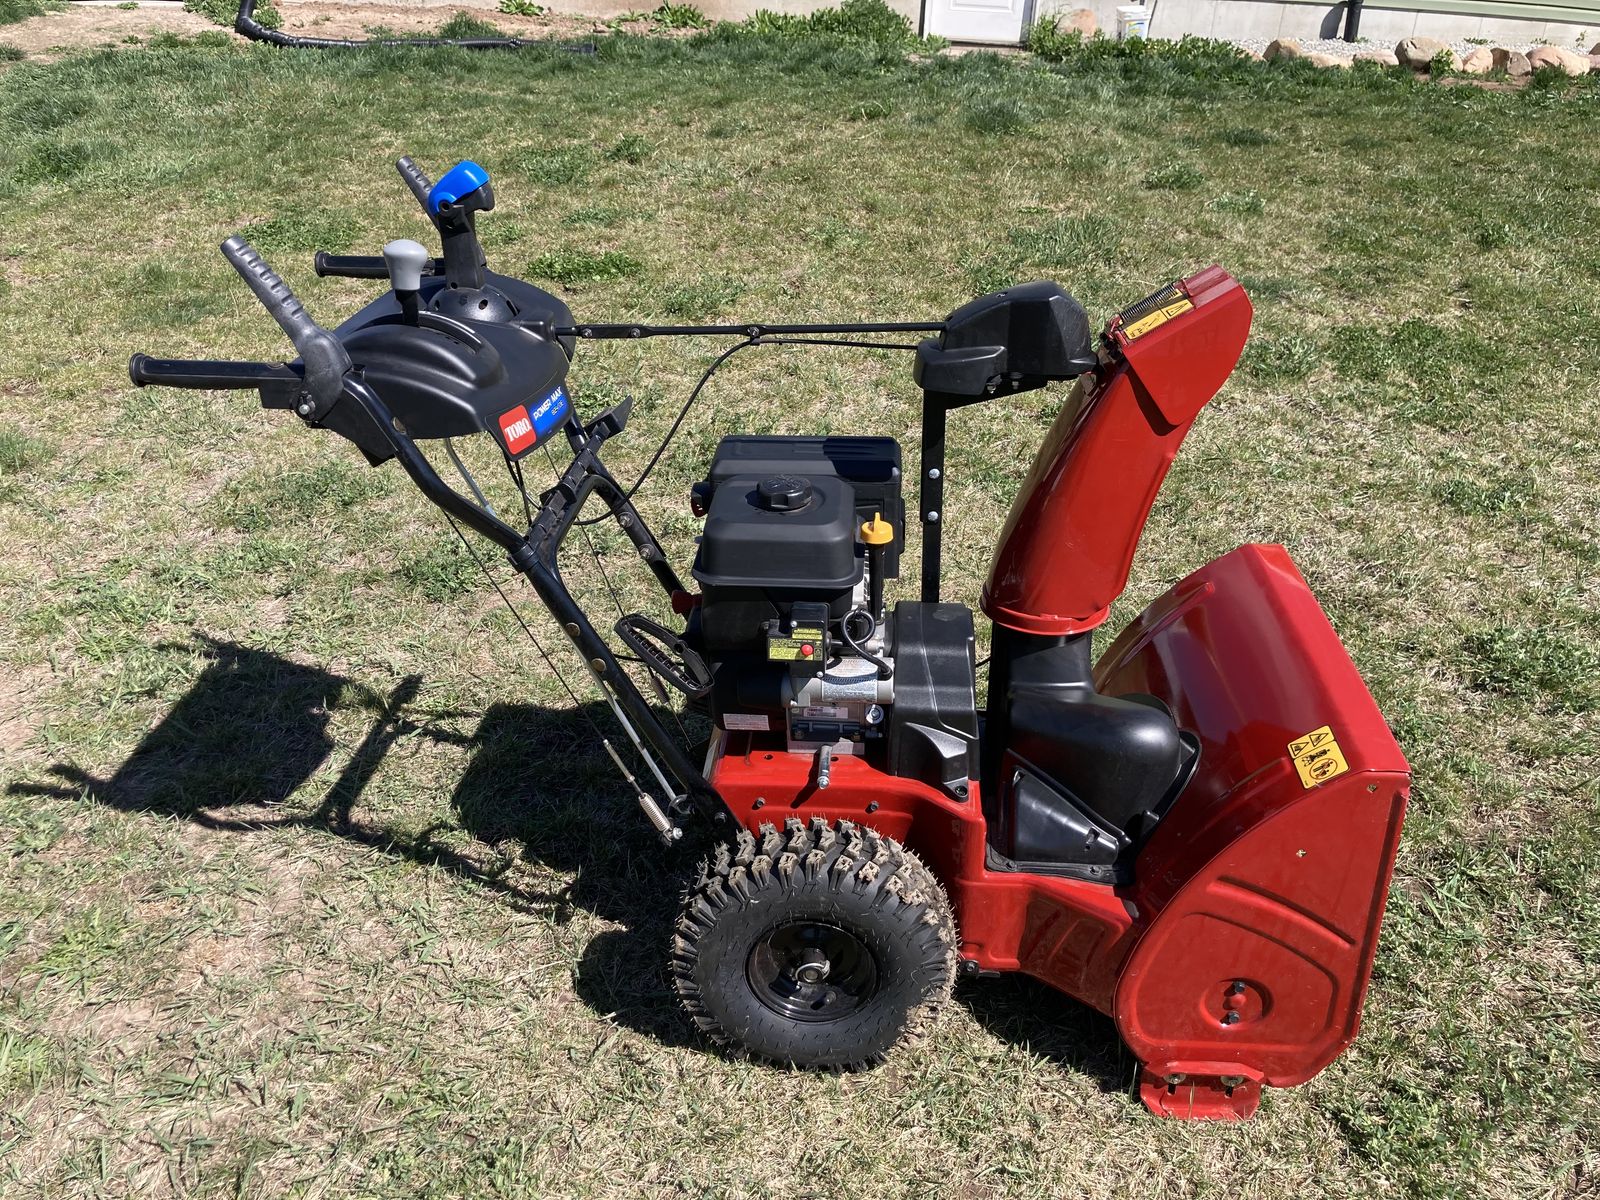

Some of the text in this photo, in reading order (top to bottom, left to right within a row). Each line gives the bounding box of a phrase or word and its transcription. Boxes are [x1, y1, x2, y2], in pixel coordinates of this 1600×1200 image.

[533, 386, 562, 421] POWER MAX
[504, 418, 530, 442] TORO
